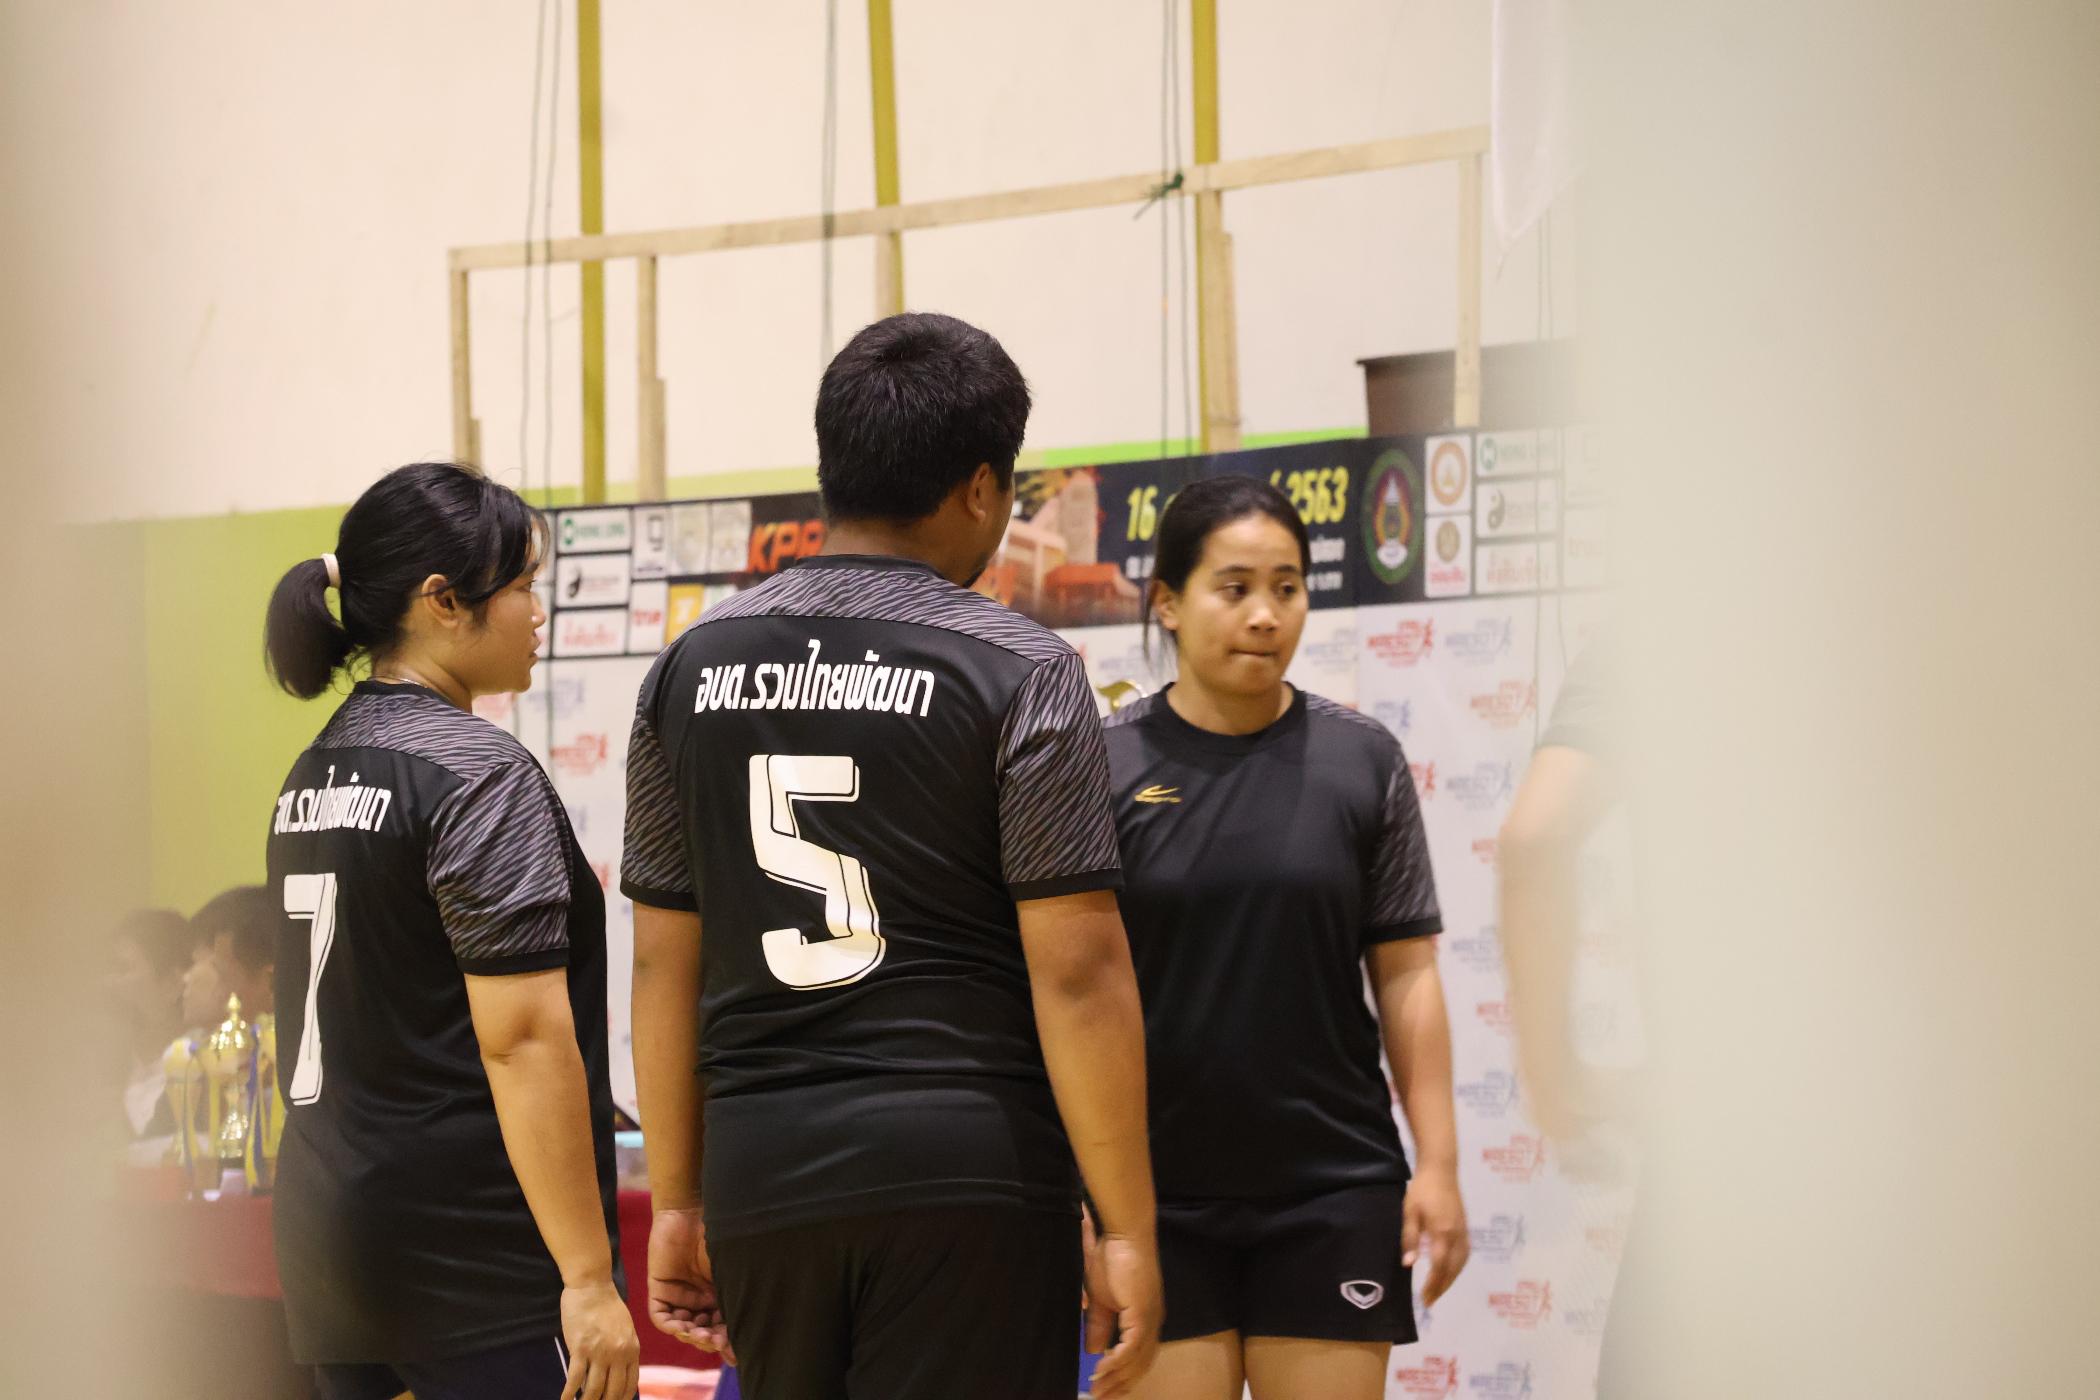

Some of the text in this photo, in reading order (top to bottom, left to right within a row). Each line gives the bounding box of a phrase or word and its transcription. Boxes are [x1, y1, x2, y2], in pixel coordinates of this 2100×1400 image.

[1126, 485, 1158, 541] 16
[694, 638, 935, 717] อบต.รวมไทยพัฒนา
[749, 753, 887, 991] 5
[284, 872, 338, 1105] 7
